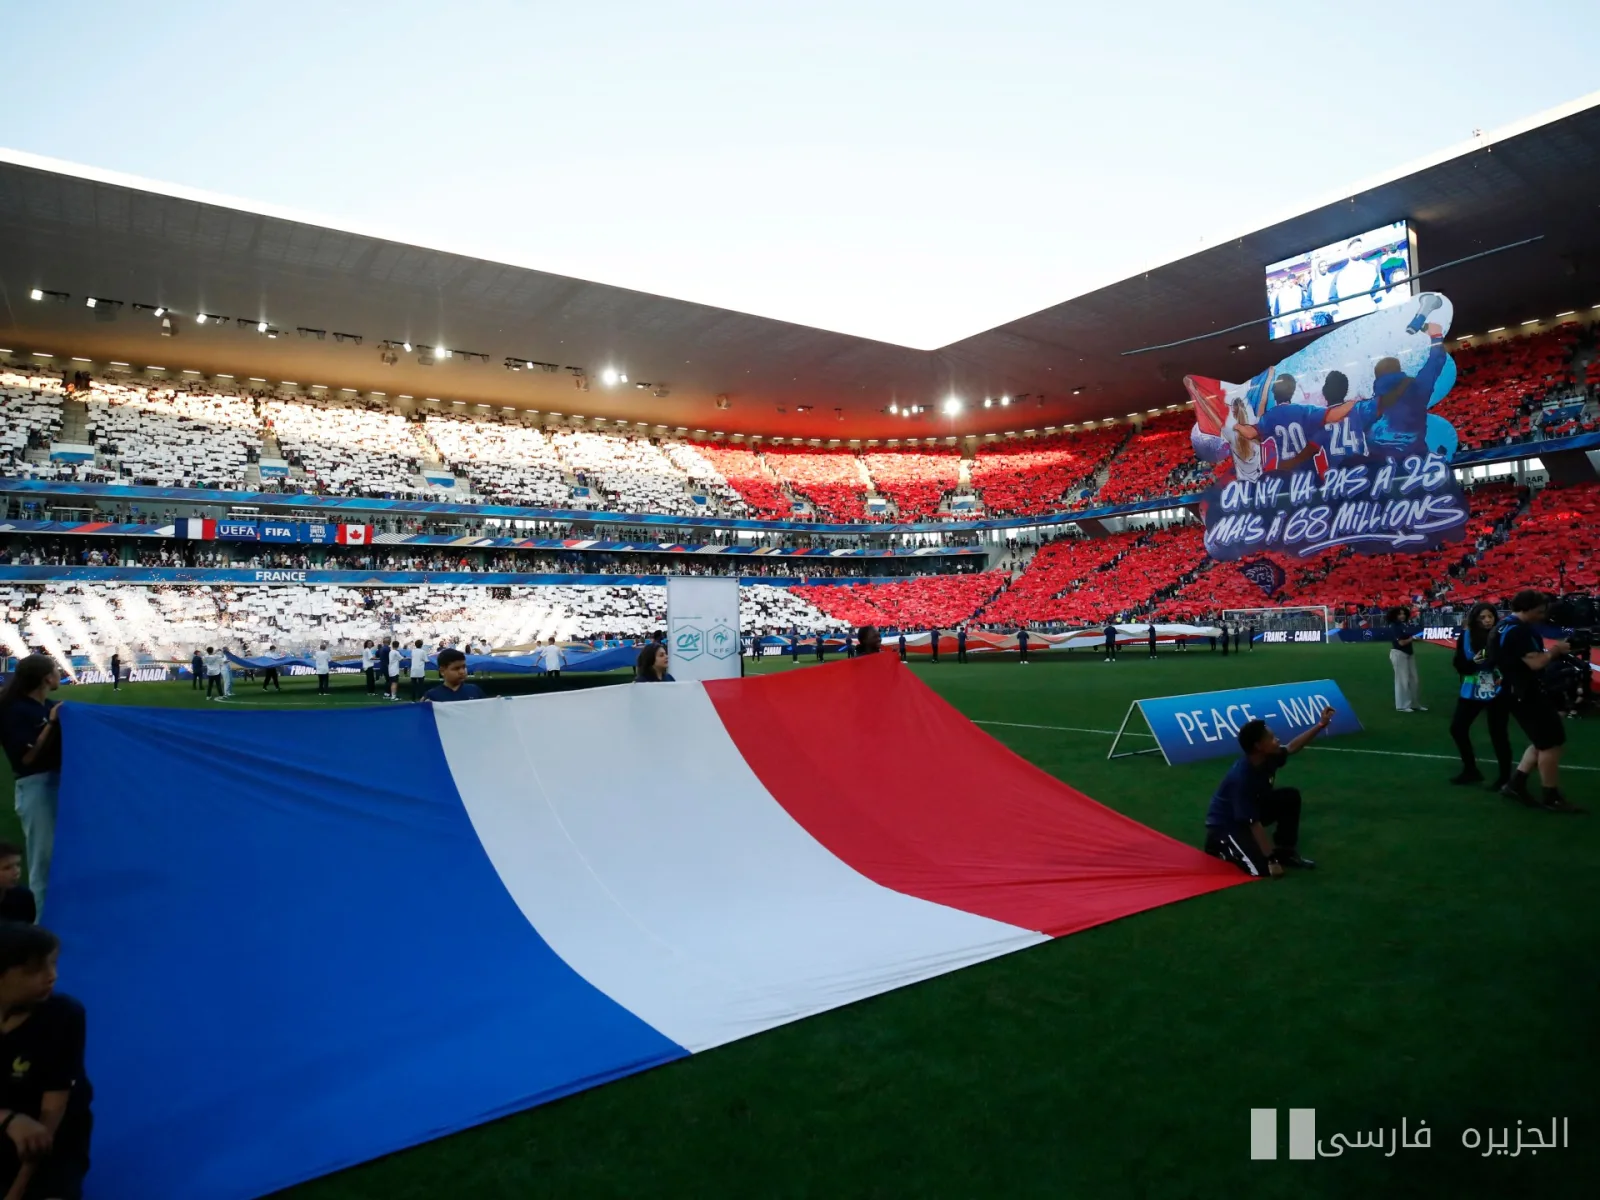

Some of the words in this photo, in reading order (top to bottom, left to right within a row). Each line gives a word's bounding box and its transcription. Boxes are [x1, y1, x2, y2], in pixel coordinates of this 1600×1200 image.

[1275, 421, 1307, 460] 20
[1324, 417, 1359, 456] 24
[1221, 480, 1250, 508] ON
[1290, 470, 1315, 502] VA
[1321, 465, 1368, 497] PAS
[1401, 453, 1447, 492] 25
[220, 525, 255, 536] UEFA
[1284, 507, 1330, 543] 68
[265, 527, 291, 537] FIFA
[255, 571, 306, 581] FRANCE
[1263, 631, 1287, 642] FRANCE
[1295, 630, 1320, 641] CANADA
[1423, 627, 1454, 640] FRANCE
[763, 647, 782, 656] CANADA
[81, 670, 115, 684] FRANC
[129, 668, 167, 682] CANADA
